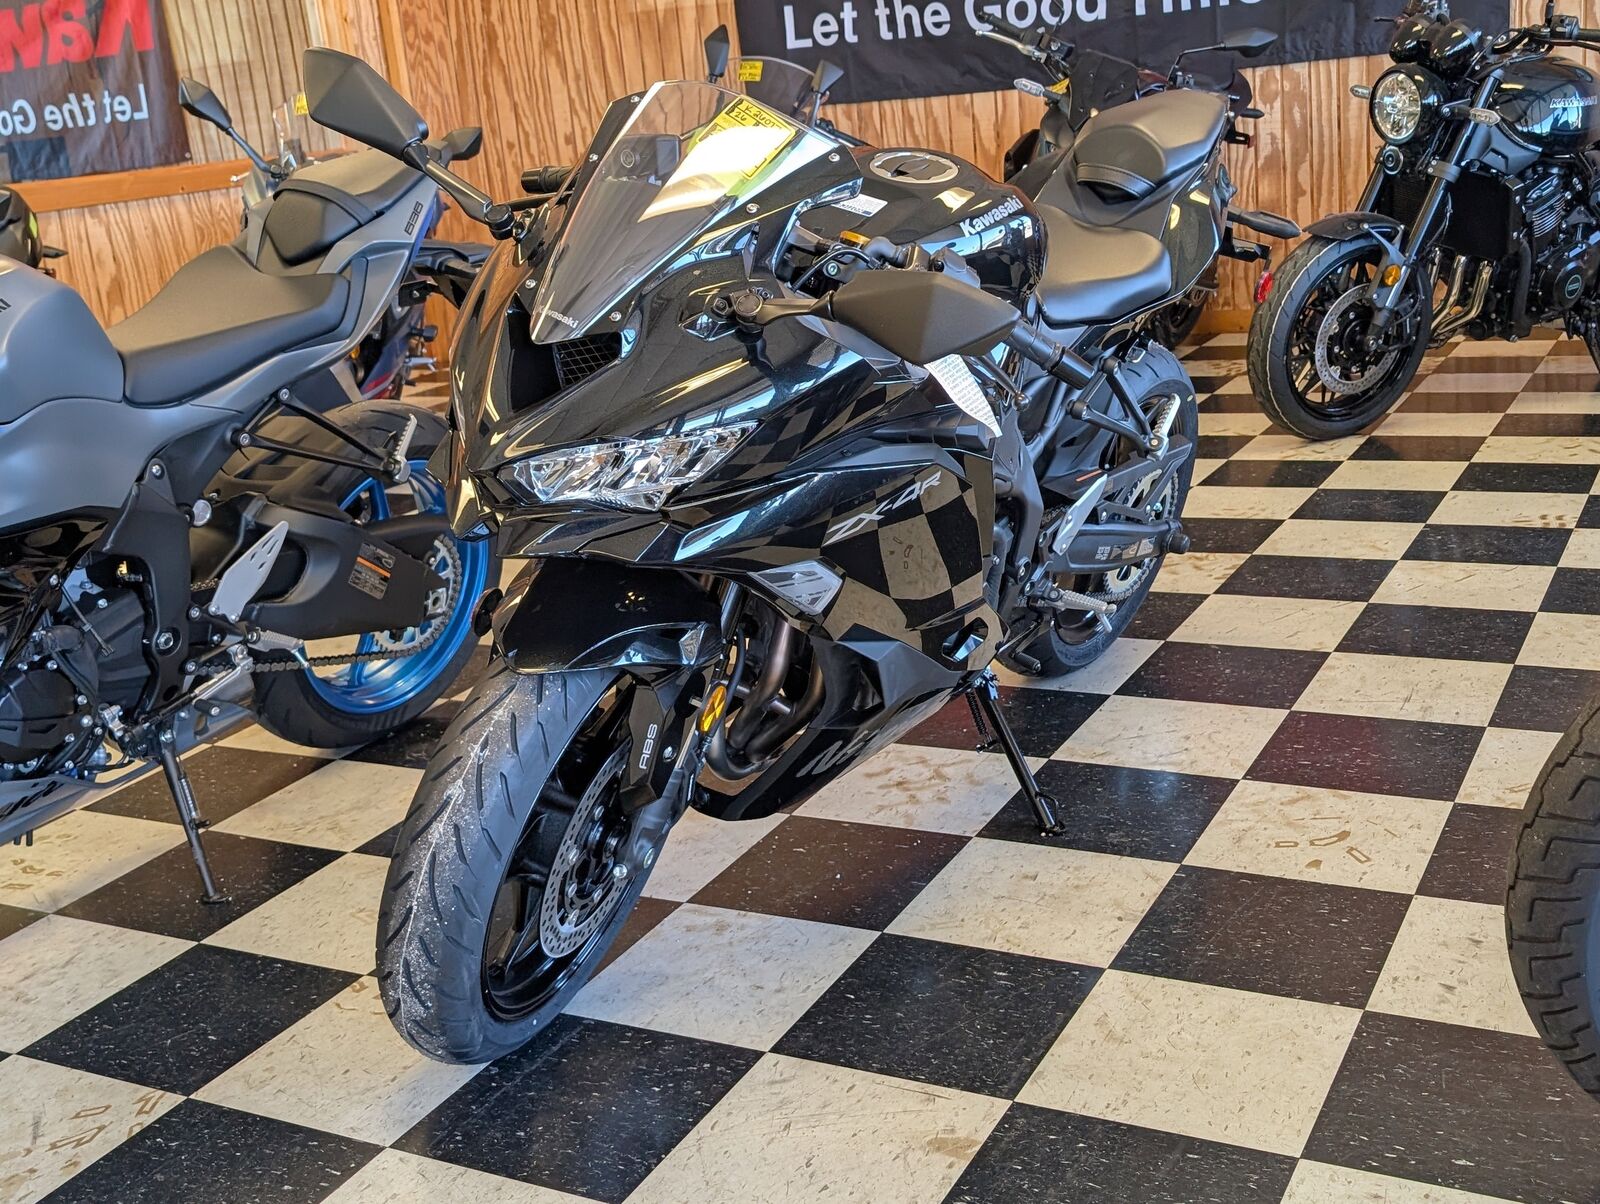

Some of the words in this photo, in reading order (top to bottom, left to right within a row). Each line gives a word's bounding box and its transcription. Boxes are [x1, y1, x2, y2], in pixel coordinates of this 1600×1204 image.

[783, 5, 859, 50] Let
[874, 0, 951, 40] the
[404, 200, 424, 236] 636
[960, 194, 1024, 238] Kawasaki
[638, 723, 658, 770] ABS
